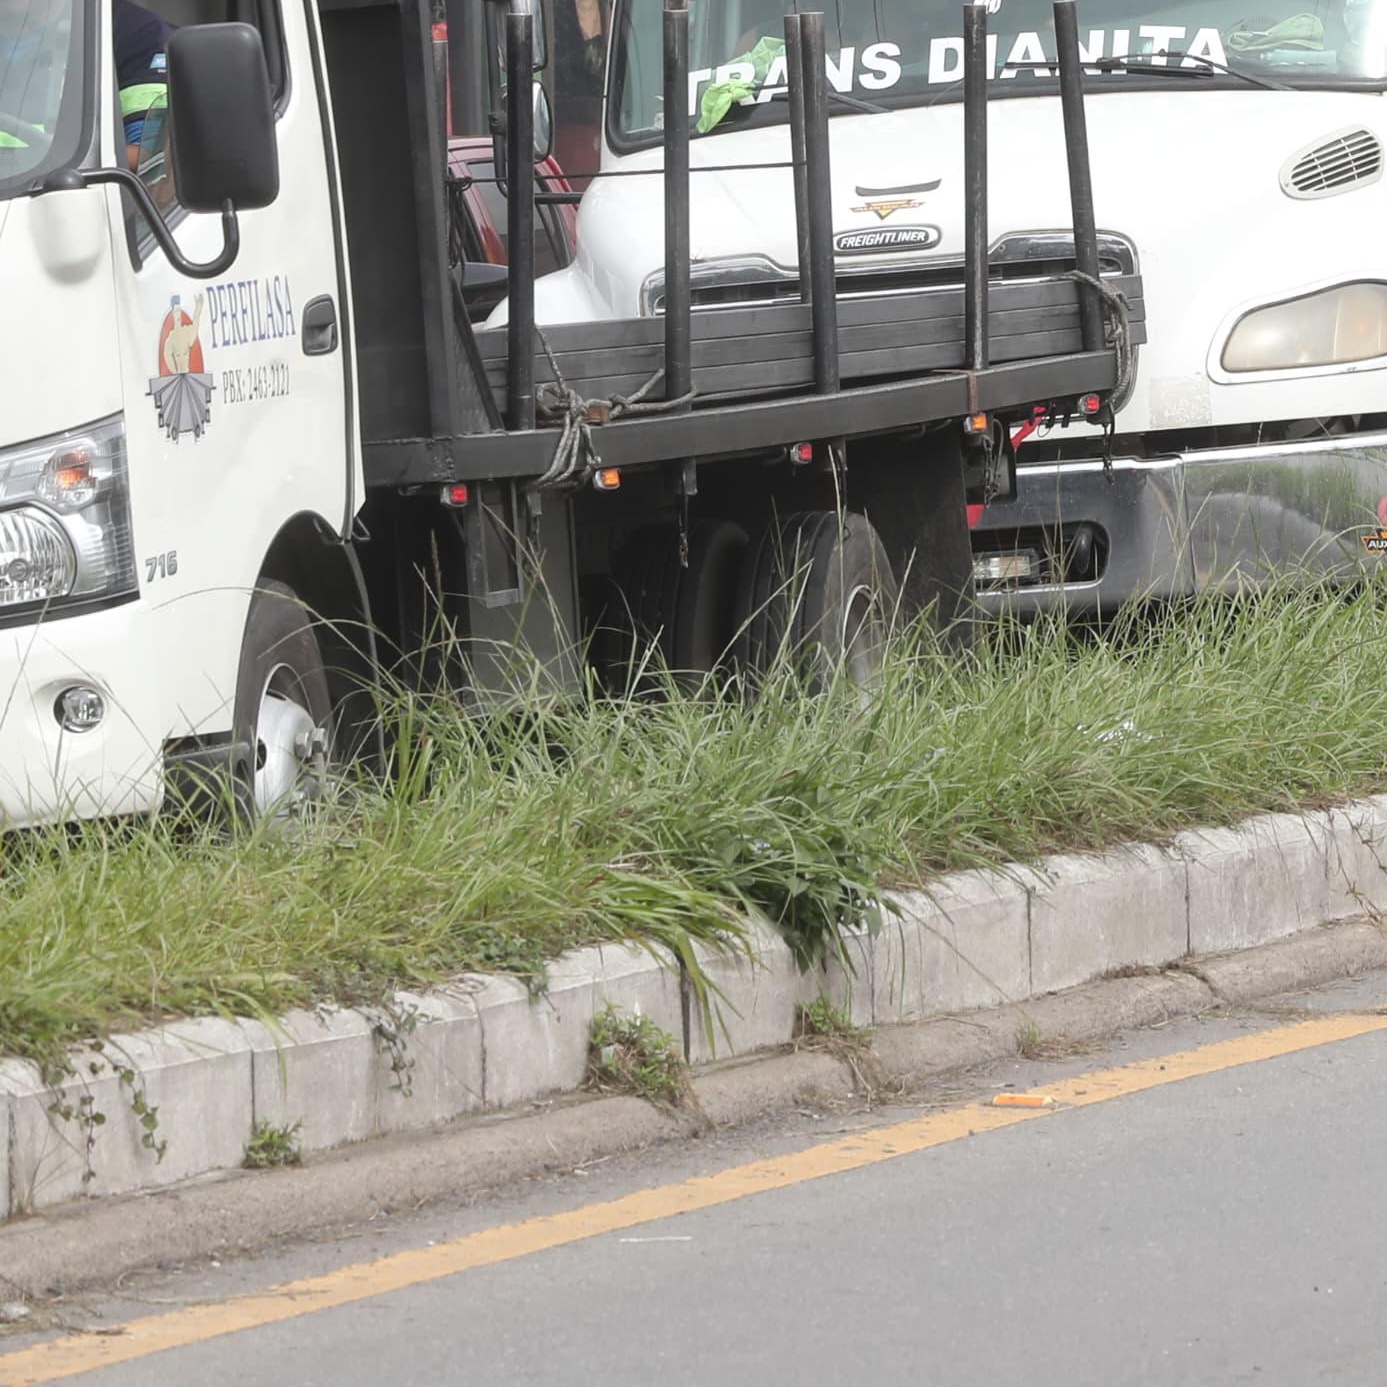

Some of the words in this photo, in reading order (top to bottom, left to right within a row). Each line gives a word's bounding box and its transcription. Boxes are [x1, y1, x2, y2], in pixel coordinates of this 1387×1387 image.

[926, 24, 1231, 87] DIANITA
[840, 230, 927, 249] FREIGHTLINER
[205, 274, 297, 349] PERFILASA
[221, 368, 246, 405] PBX:
[144, 550, 179, 584] 716
